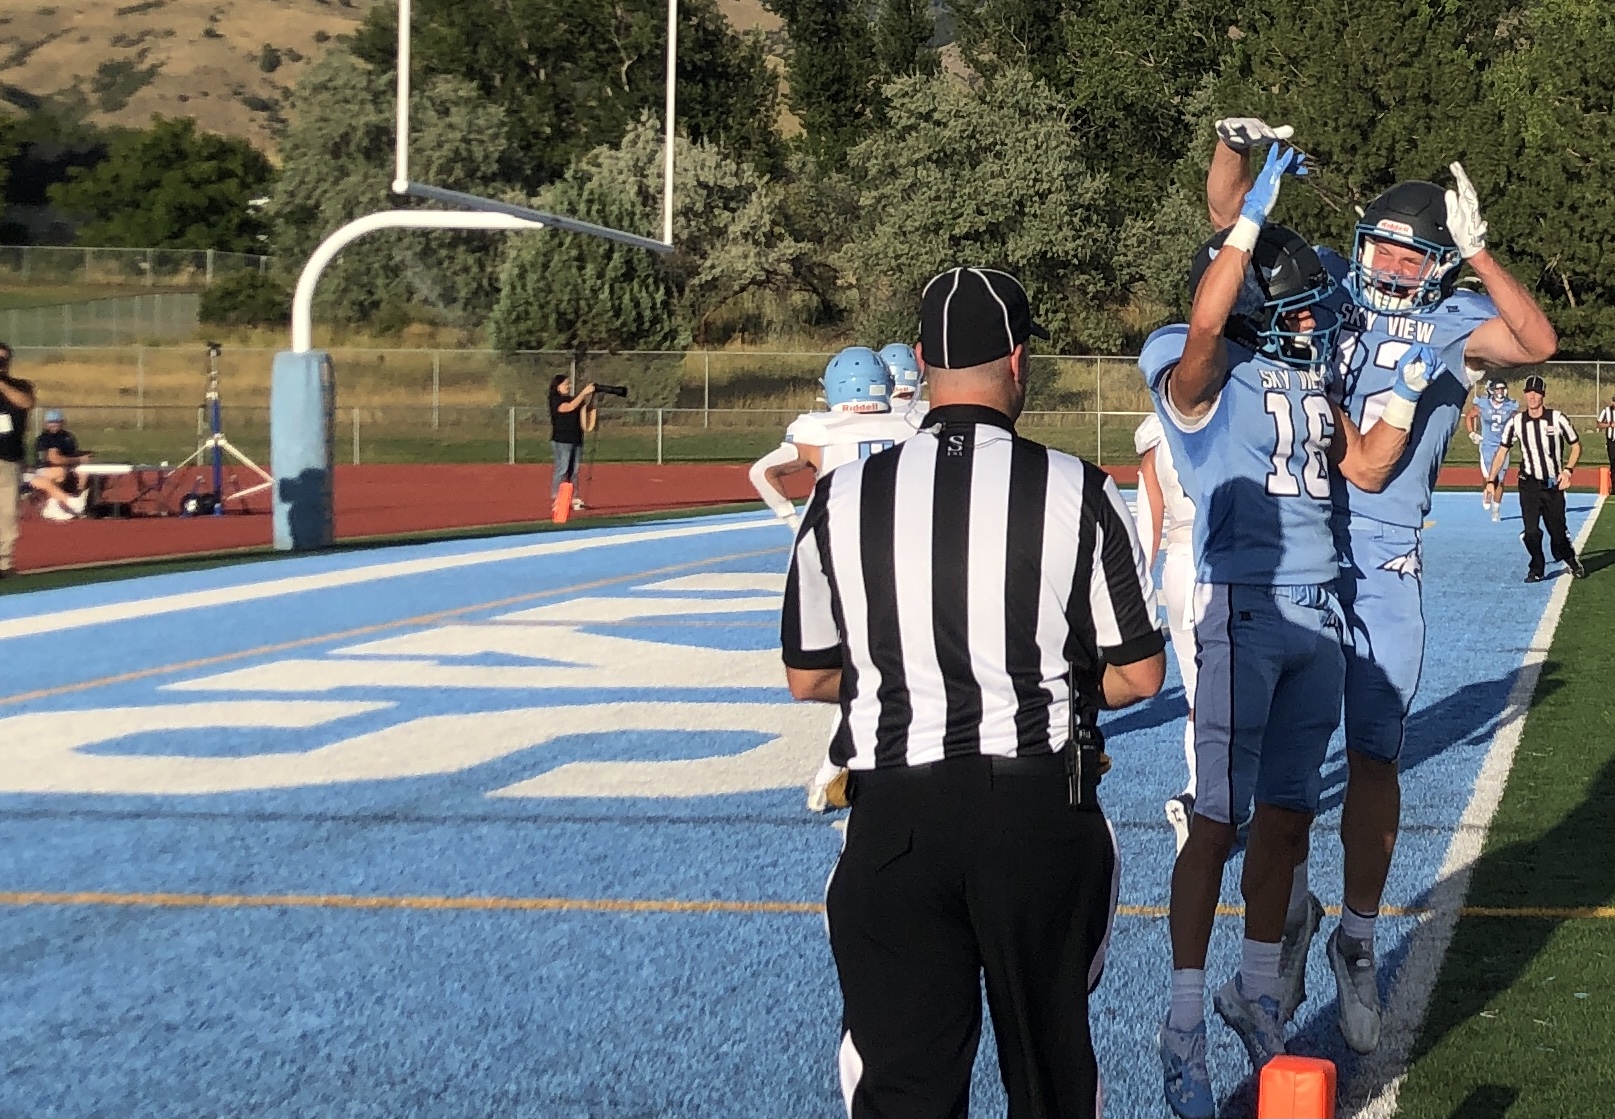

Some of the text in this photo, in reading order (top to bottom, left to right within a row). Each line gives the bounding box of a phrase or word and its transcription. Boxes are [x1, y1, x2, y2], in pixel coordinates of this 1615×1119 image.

[1341, 302, 1435, 344] SKY VIEW
[1257, 370, 1290, 391] SKY
[842, 403, 878, 412] Riddell
[1491, 414, 1502, 432] 2
